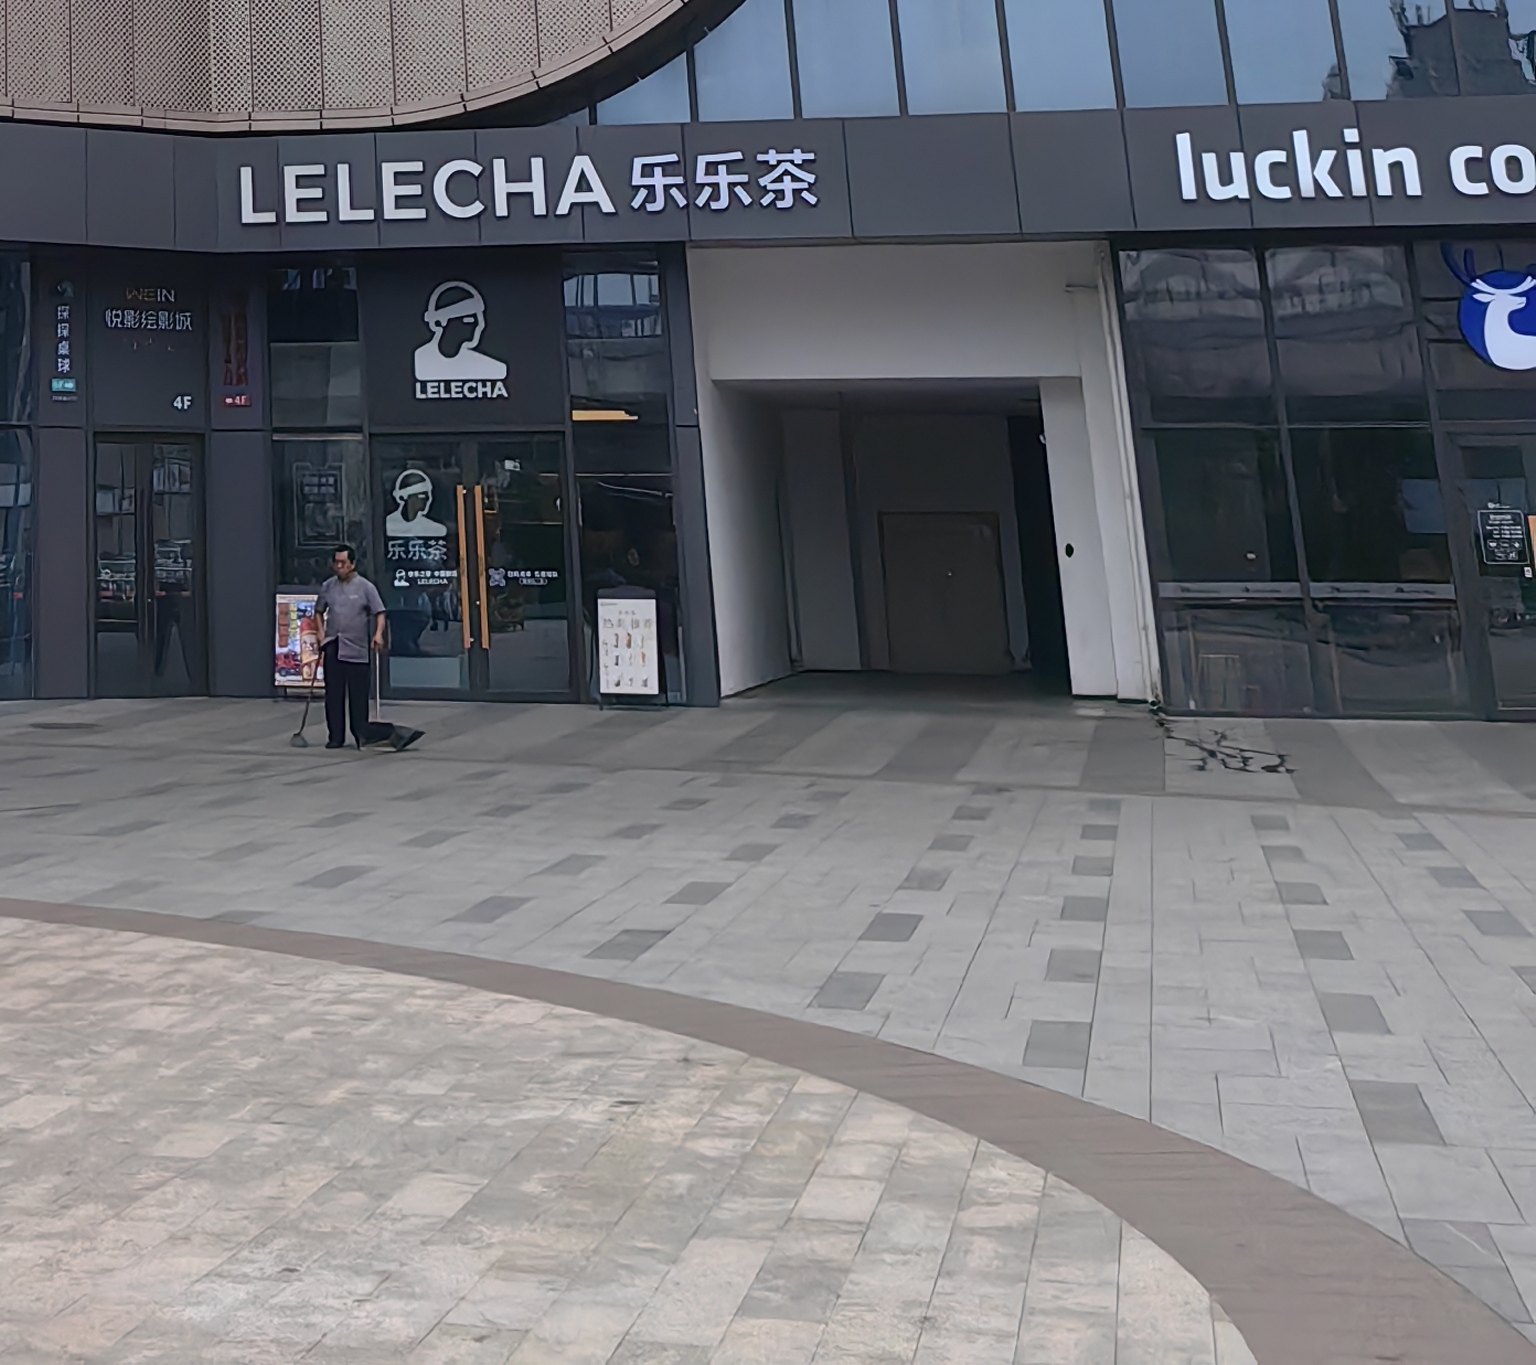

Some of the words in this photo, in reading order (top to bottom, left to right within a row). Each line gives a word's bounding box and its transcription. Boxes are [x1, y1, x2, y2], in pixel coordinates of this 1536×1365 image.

[1175, 127, 1423, 201] luckin
[240, 154, 617, 225] LELECHA
[630, 148, 819, 212] 乐乐茶
[125, 287, 175, 303] WEIN
[105, 308, 193, 331] 悦影绘影城
[415, 379, 509, 400] LELECHA
[173, 395, 193, 410] 4F
[386, 538, 448, 561] 乐乐茶
